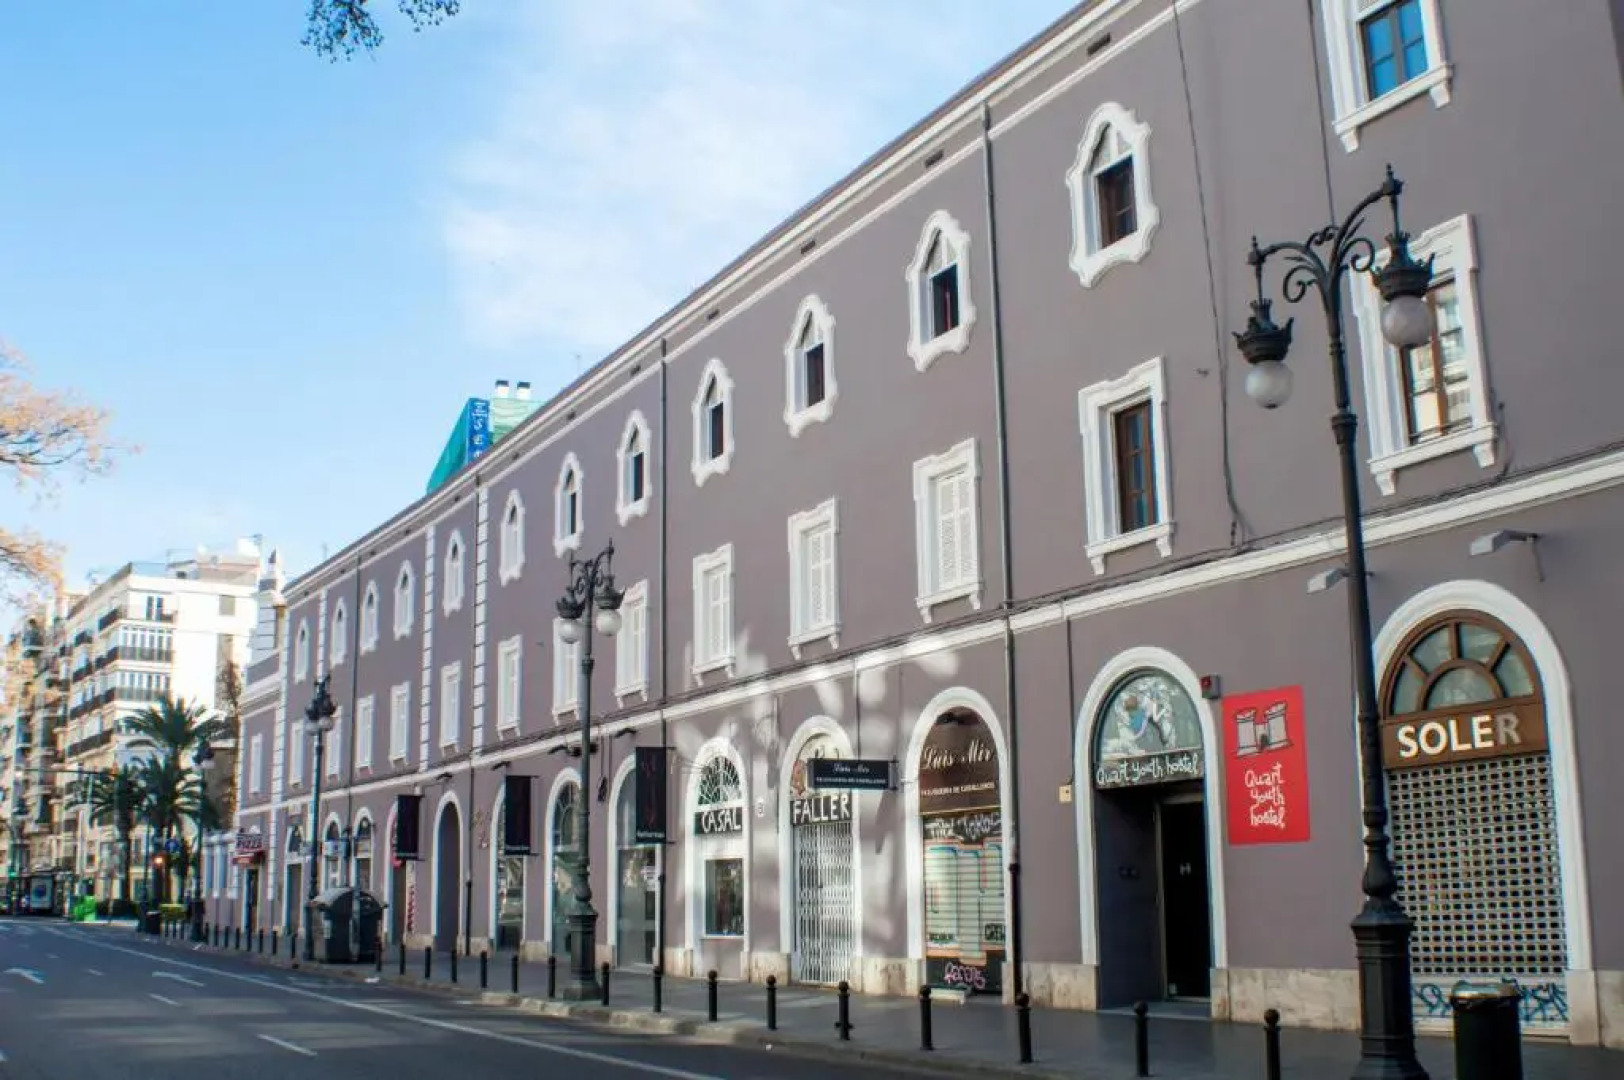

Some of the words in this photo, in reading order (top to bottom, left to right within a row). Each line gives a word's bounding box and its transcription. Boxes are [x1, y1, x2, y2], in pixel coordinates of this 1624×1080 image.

[1397, 712, 1522, 758] SOLER
[1096, 762, 1130, 785] Quart
[1166, 753, 1200, 775] hostel
[1244, 761, 1284, 788] Quart
[792, 793, 852, 824] FALLER
[1251, 787, 1285, 806] youth
[701, 806, 742, 833] CASAL
[1250, 805, 1285, 828] hostel
